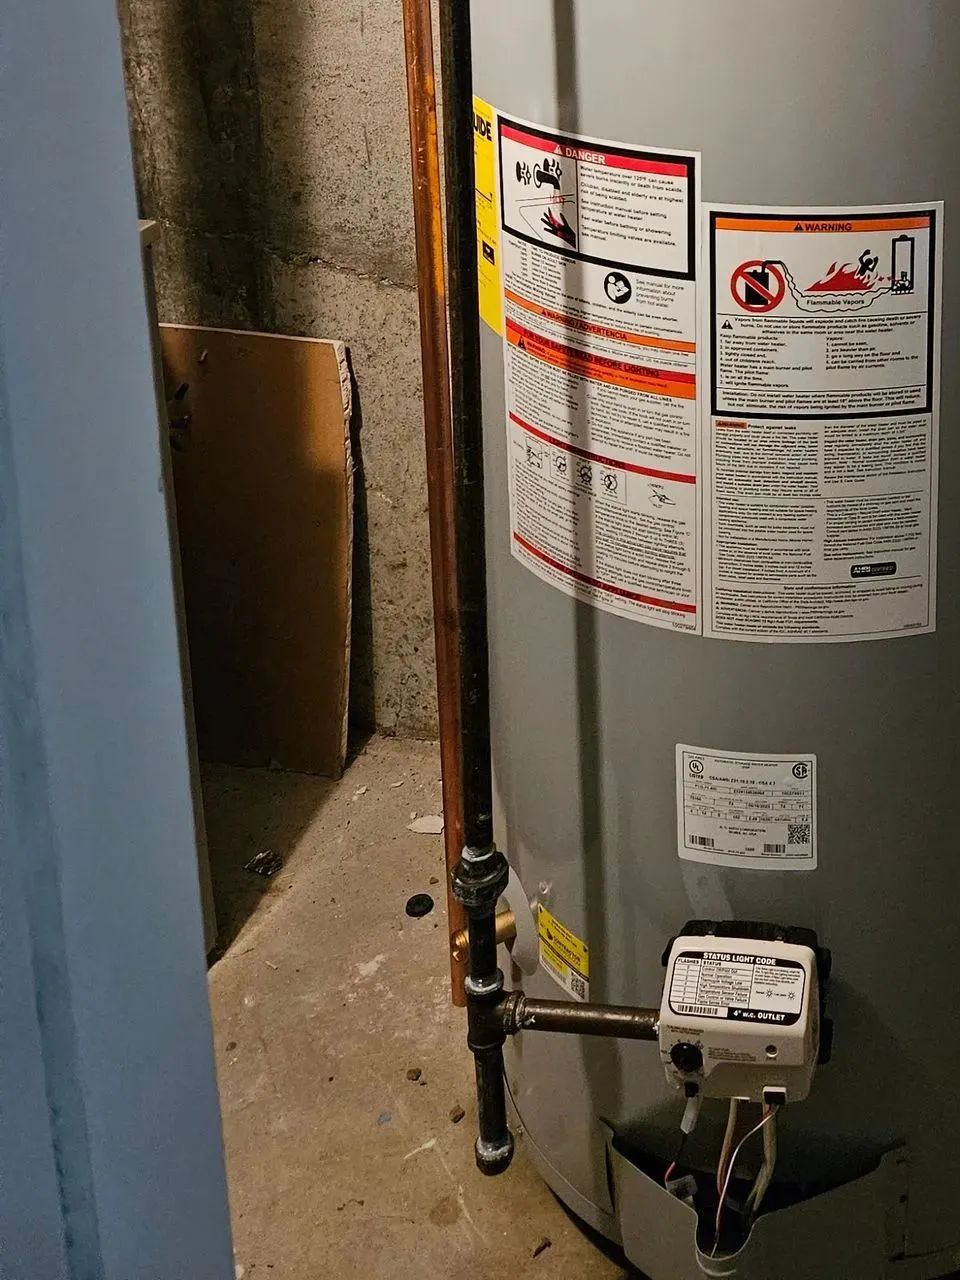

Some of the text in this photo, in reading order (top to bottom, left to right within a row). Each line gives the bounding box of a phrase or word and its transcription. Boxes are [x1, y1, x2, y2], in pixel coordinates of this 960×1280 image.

[473, 112, 492, 141] UIDE
[565, 147, 606, 165] DANGER
[805, 222, 853, 232] WARNING
[624, 363, 660, 379] LIGHTING
[703, 952, 777, 966] STATUS LIGHT CODE
[757, 1012, 786, 1022] OUTLET
